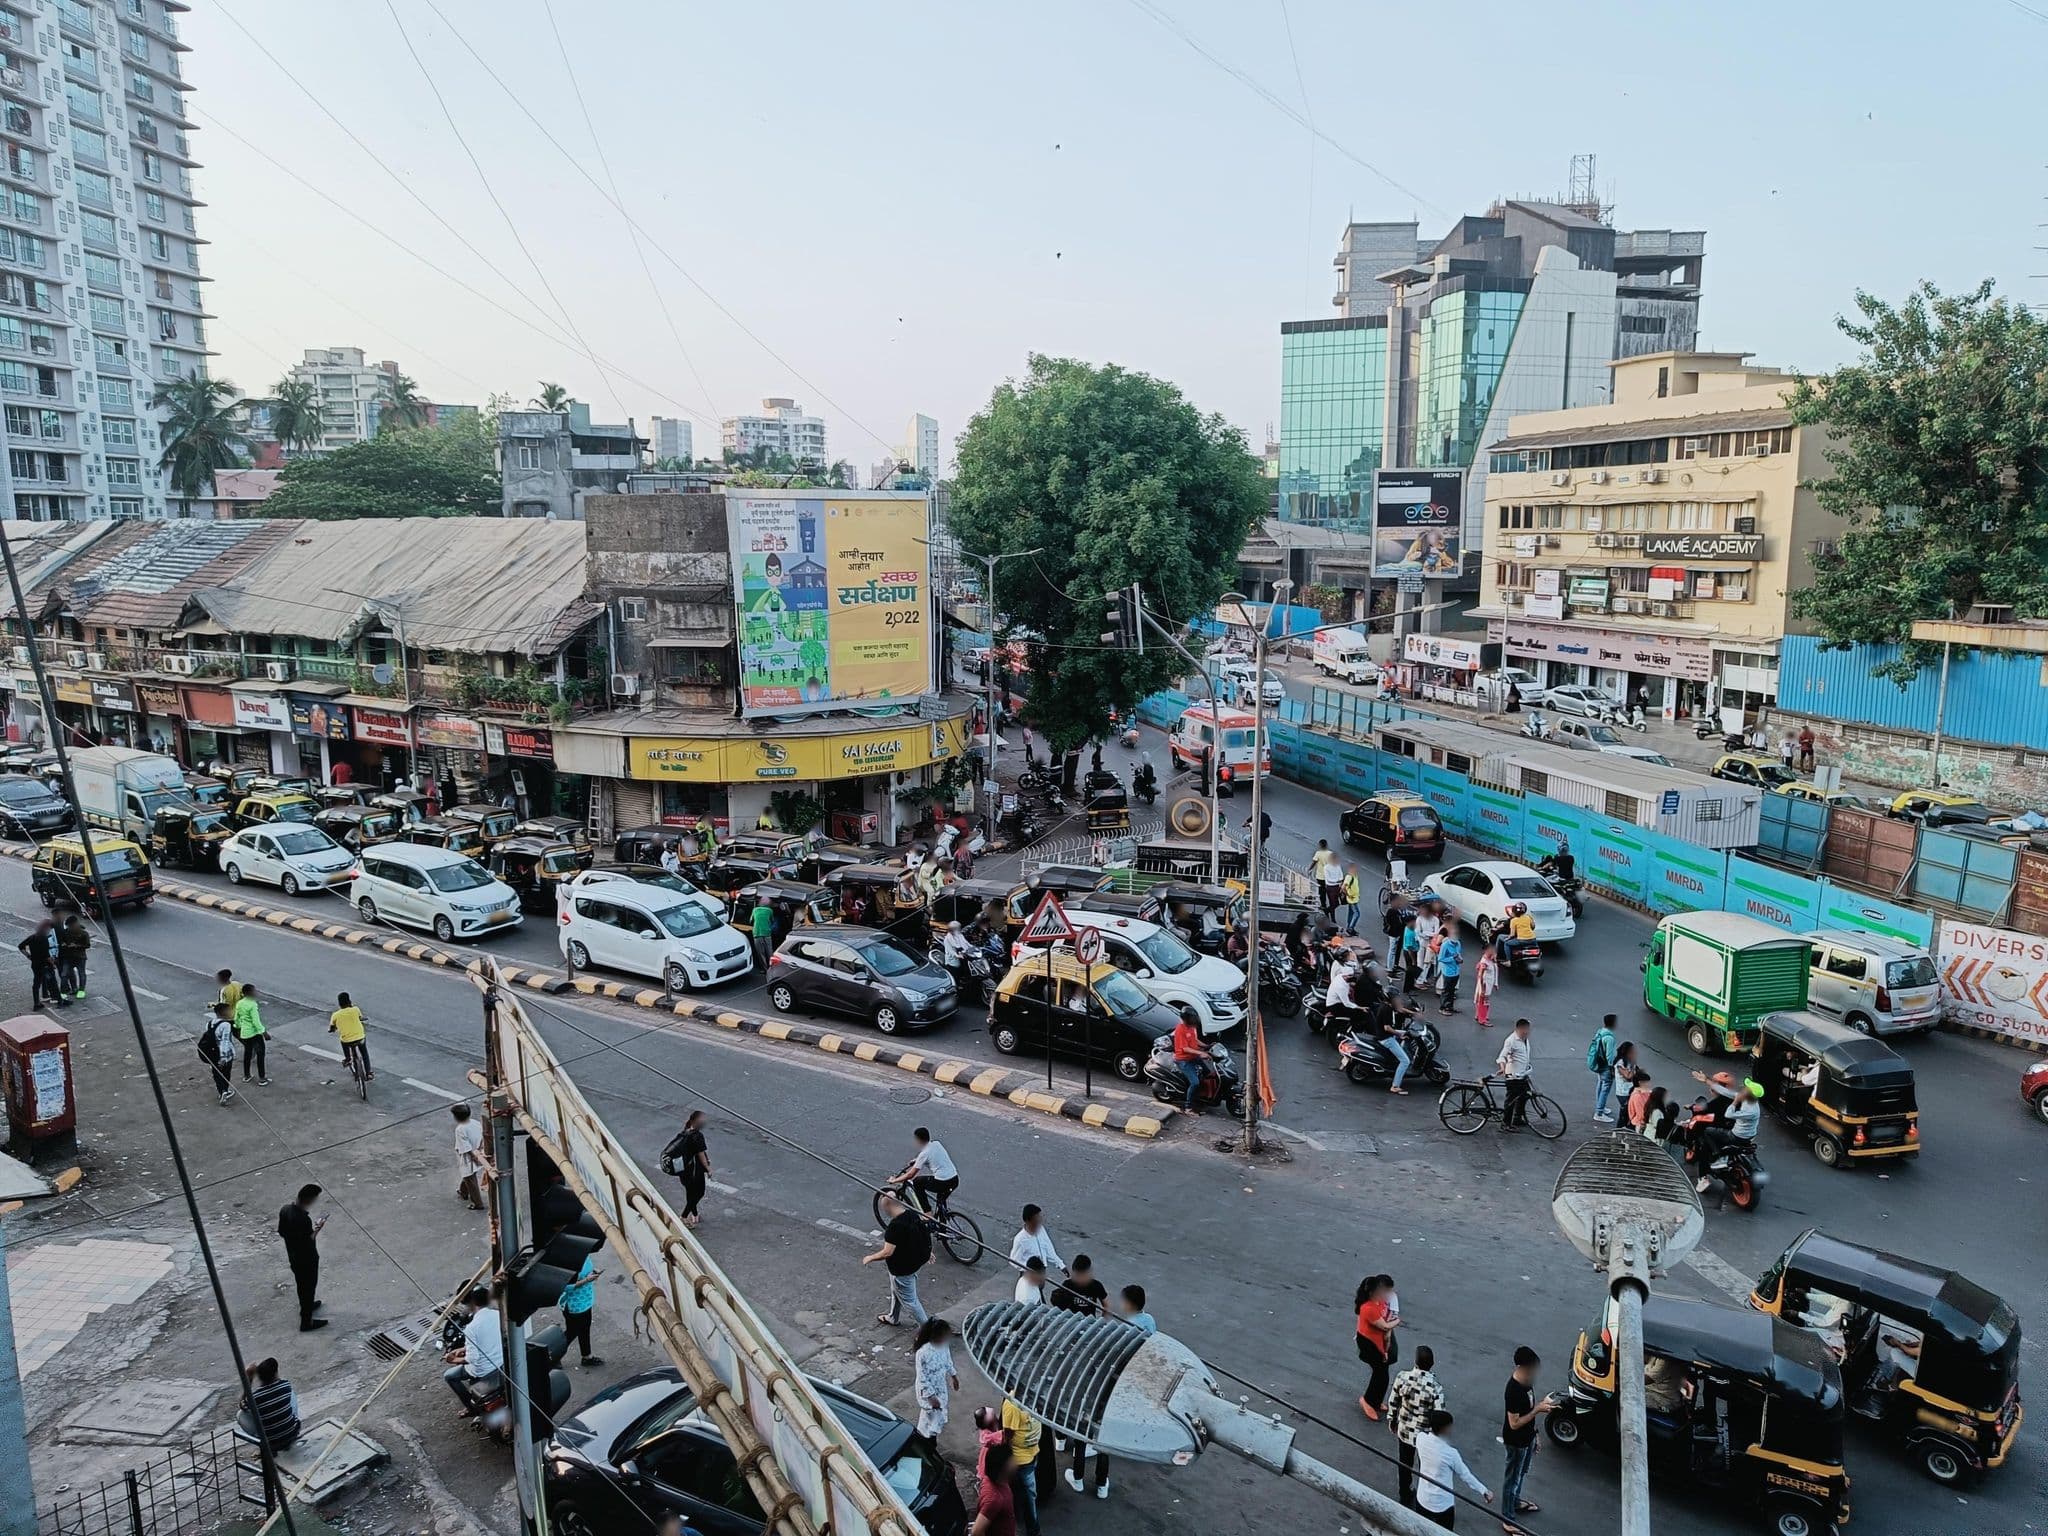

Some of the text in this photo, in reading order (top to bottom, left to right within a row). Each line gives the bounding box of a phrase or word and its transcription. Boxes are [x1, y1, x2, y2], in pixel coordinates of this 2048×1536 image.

[1646, 536, 1756, 554] LAKMÉ ACADEMY
[839, 548, 884, 561] आम्ही तयार
[848, 563, 870, 571] आहोत
[880, 571, 918, 582] स्वच्छ
[838, 580, 918, 605] सर्वेक्षण
[885, 611, 920, 628] 2022
[93, 681, 119, 696] Ranka
[843, 740, 903, 759] SAI SAGAR
[874, 764, 895, 772] BANDRA
[1431, 791, 1456, 808] MMRDA
[1481, 808, 1509, 826] MMRDA
[1538, 824, 1568, 842] MMRDA
[1599, 846, 1631, 867] MMRDA
[1666, 869, 1704, 894] MMRDA
[1746, 898, 1792, 927] MMRDA
[1953, 929, 2048, 961] DIVERS
[1975, 1011, 2048, 1037] GO SLOW
